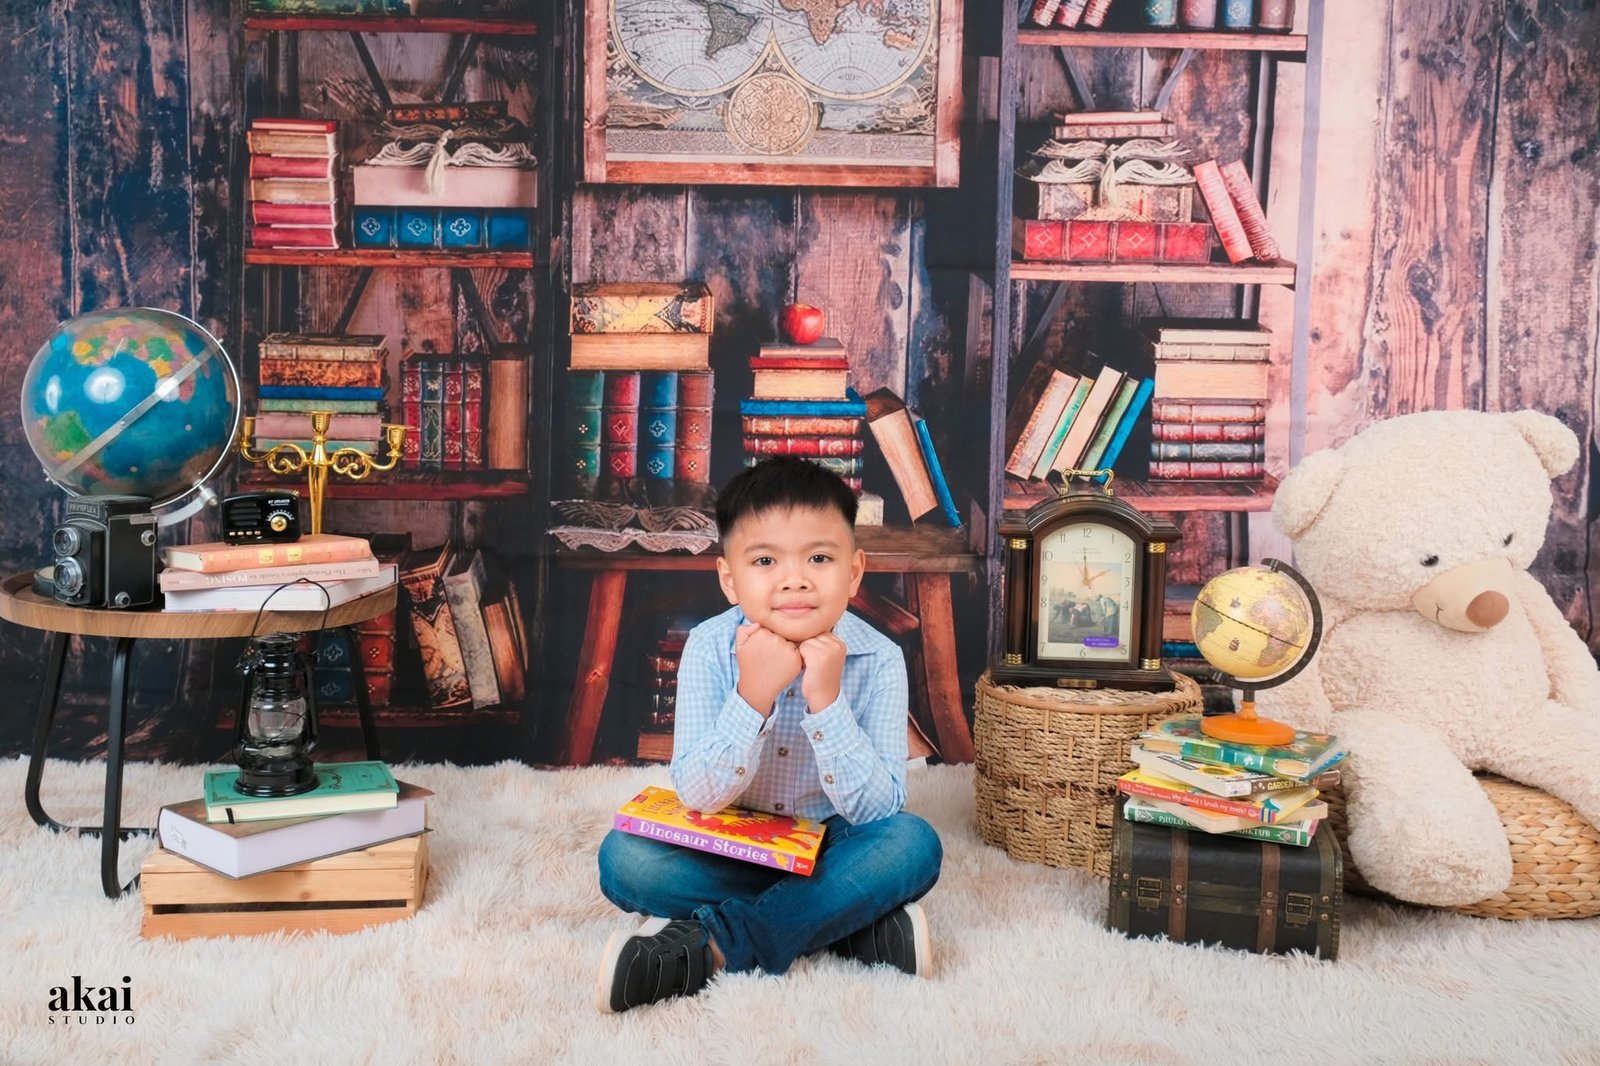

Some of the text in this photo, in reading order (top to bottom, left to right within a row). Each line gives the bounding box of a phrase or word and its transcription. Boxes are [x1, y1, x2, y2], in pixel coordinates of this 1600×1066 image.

[1060, 533, 1066, 543] 11
[1082, 528, 1092, 538] 12
[1042, 551, 1053, 561] 10
[1125, 553, 1131, 563] 2
[205, 574, 248, 585] POSING
[1042, 575, 1048, 585] 9
[1125, 577, 1131, 587] 3
[1041, 598, 1047, 608] 8
[1122, 600, 1129, 610] 4
[1040, 642, 1046, 653] 7
[1120, 645, 1127, 655] 5
[1080, 648, 1086, 658] 6
[1267, 780, 1294, 791] GARDEN
[1171, 792, 1185, 802] Why
[1184, 795, 1199, 805] should
[1220, 804, 1229, 812] my
[638, 820, 769, 862] Dinosaur Stories
